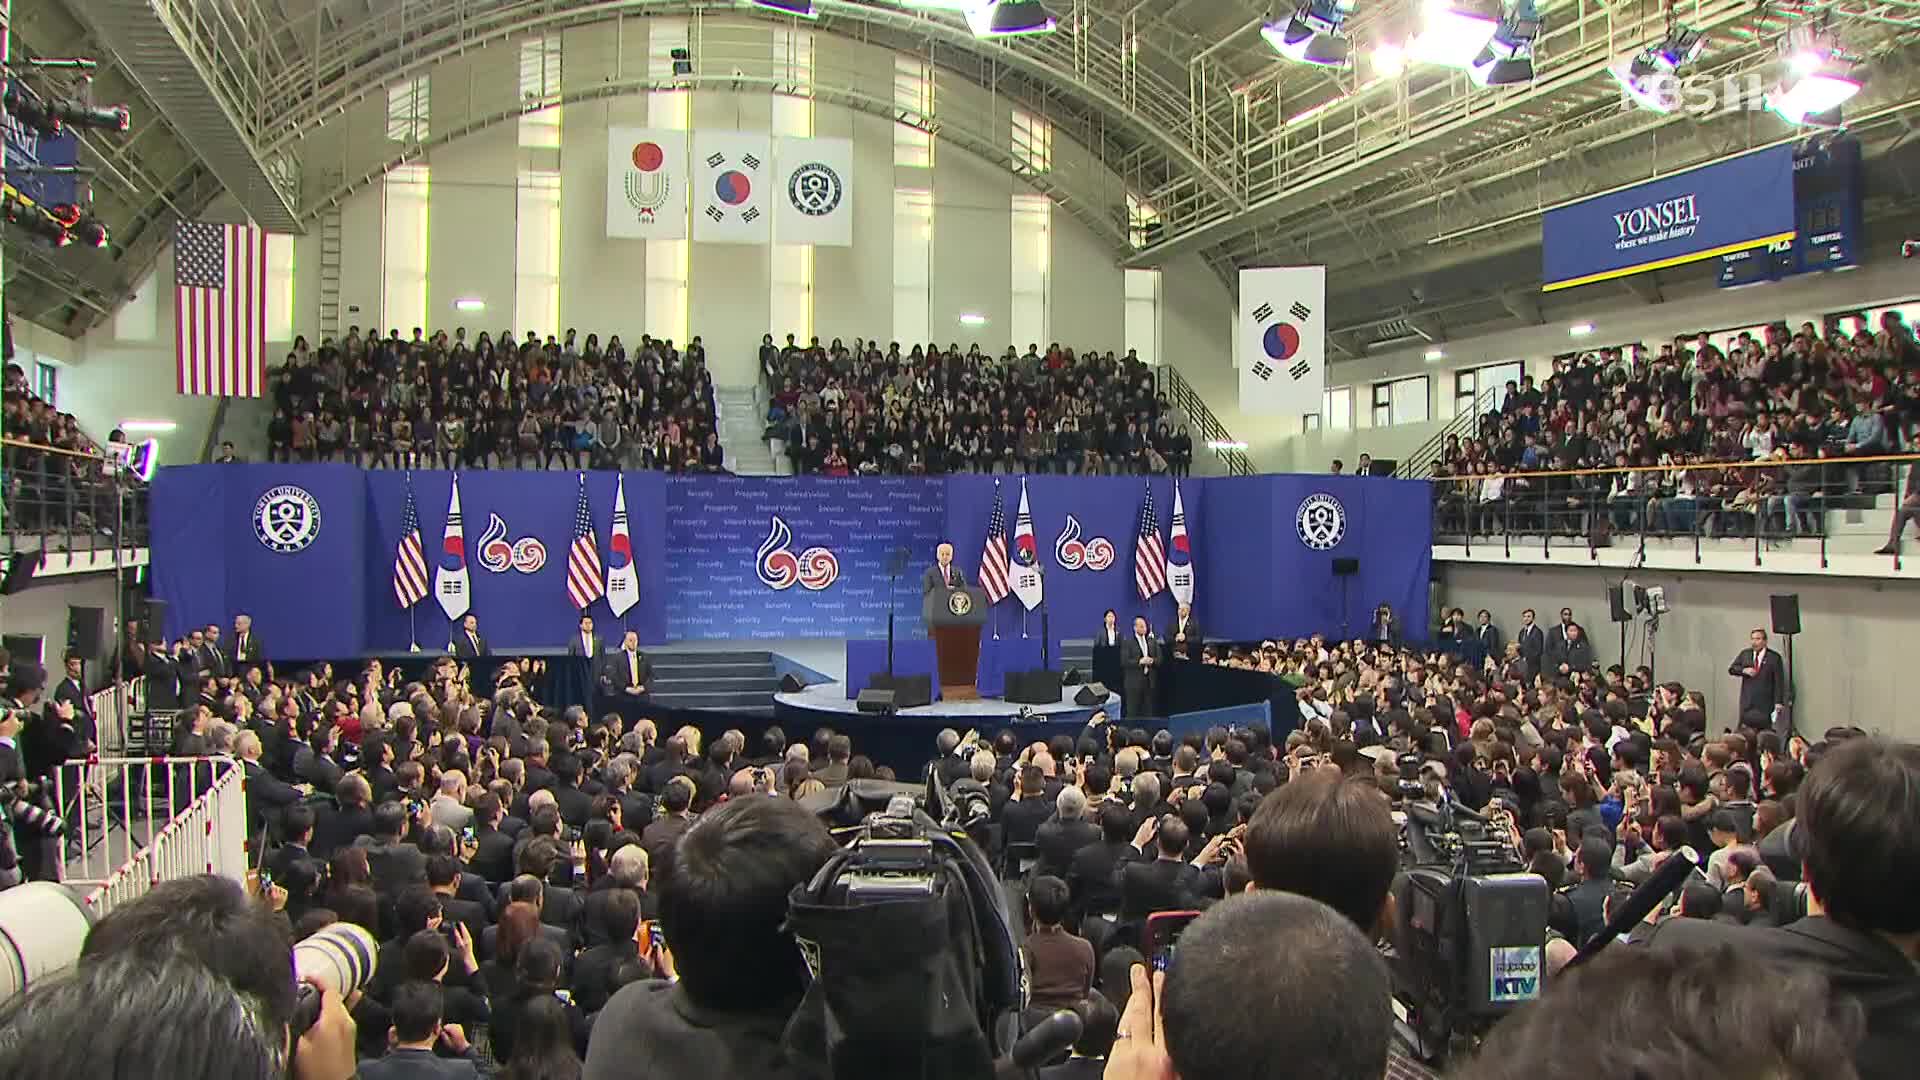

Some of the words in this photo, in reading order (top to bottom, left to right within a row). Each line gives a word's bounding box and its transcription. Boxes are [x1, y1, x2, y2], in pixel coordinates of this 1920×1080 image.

[1613, 194, 1700, 238] YONSEI,
[1615, 240, 1638, 250] where
[1637, 237, 1649, 246] we
[1648, 230, 1669, 244] make
[1668, 225, 1696, 239] history
[1495, 976, 1537, 994] KTV
